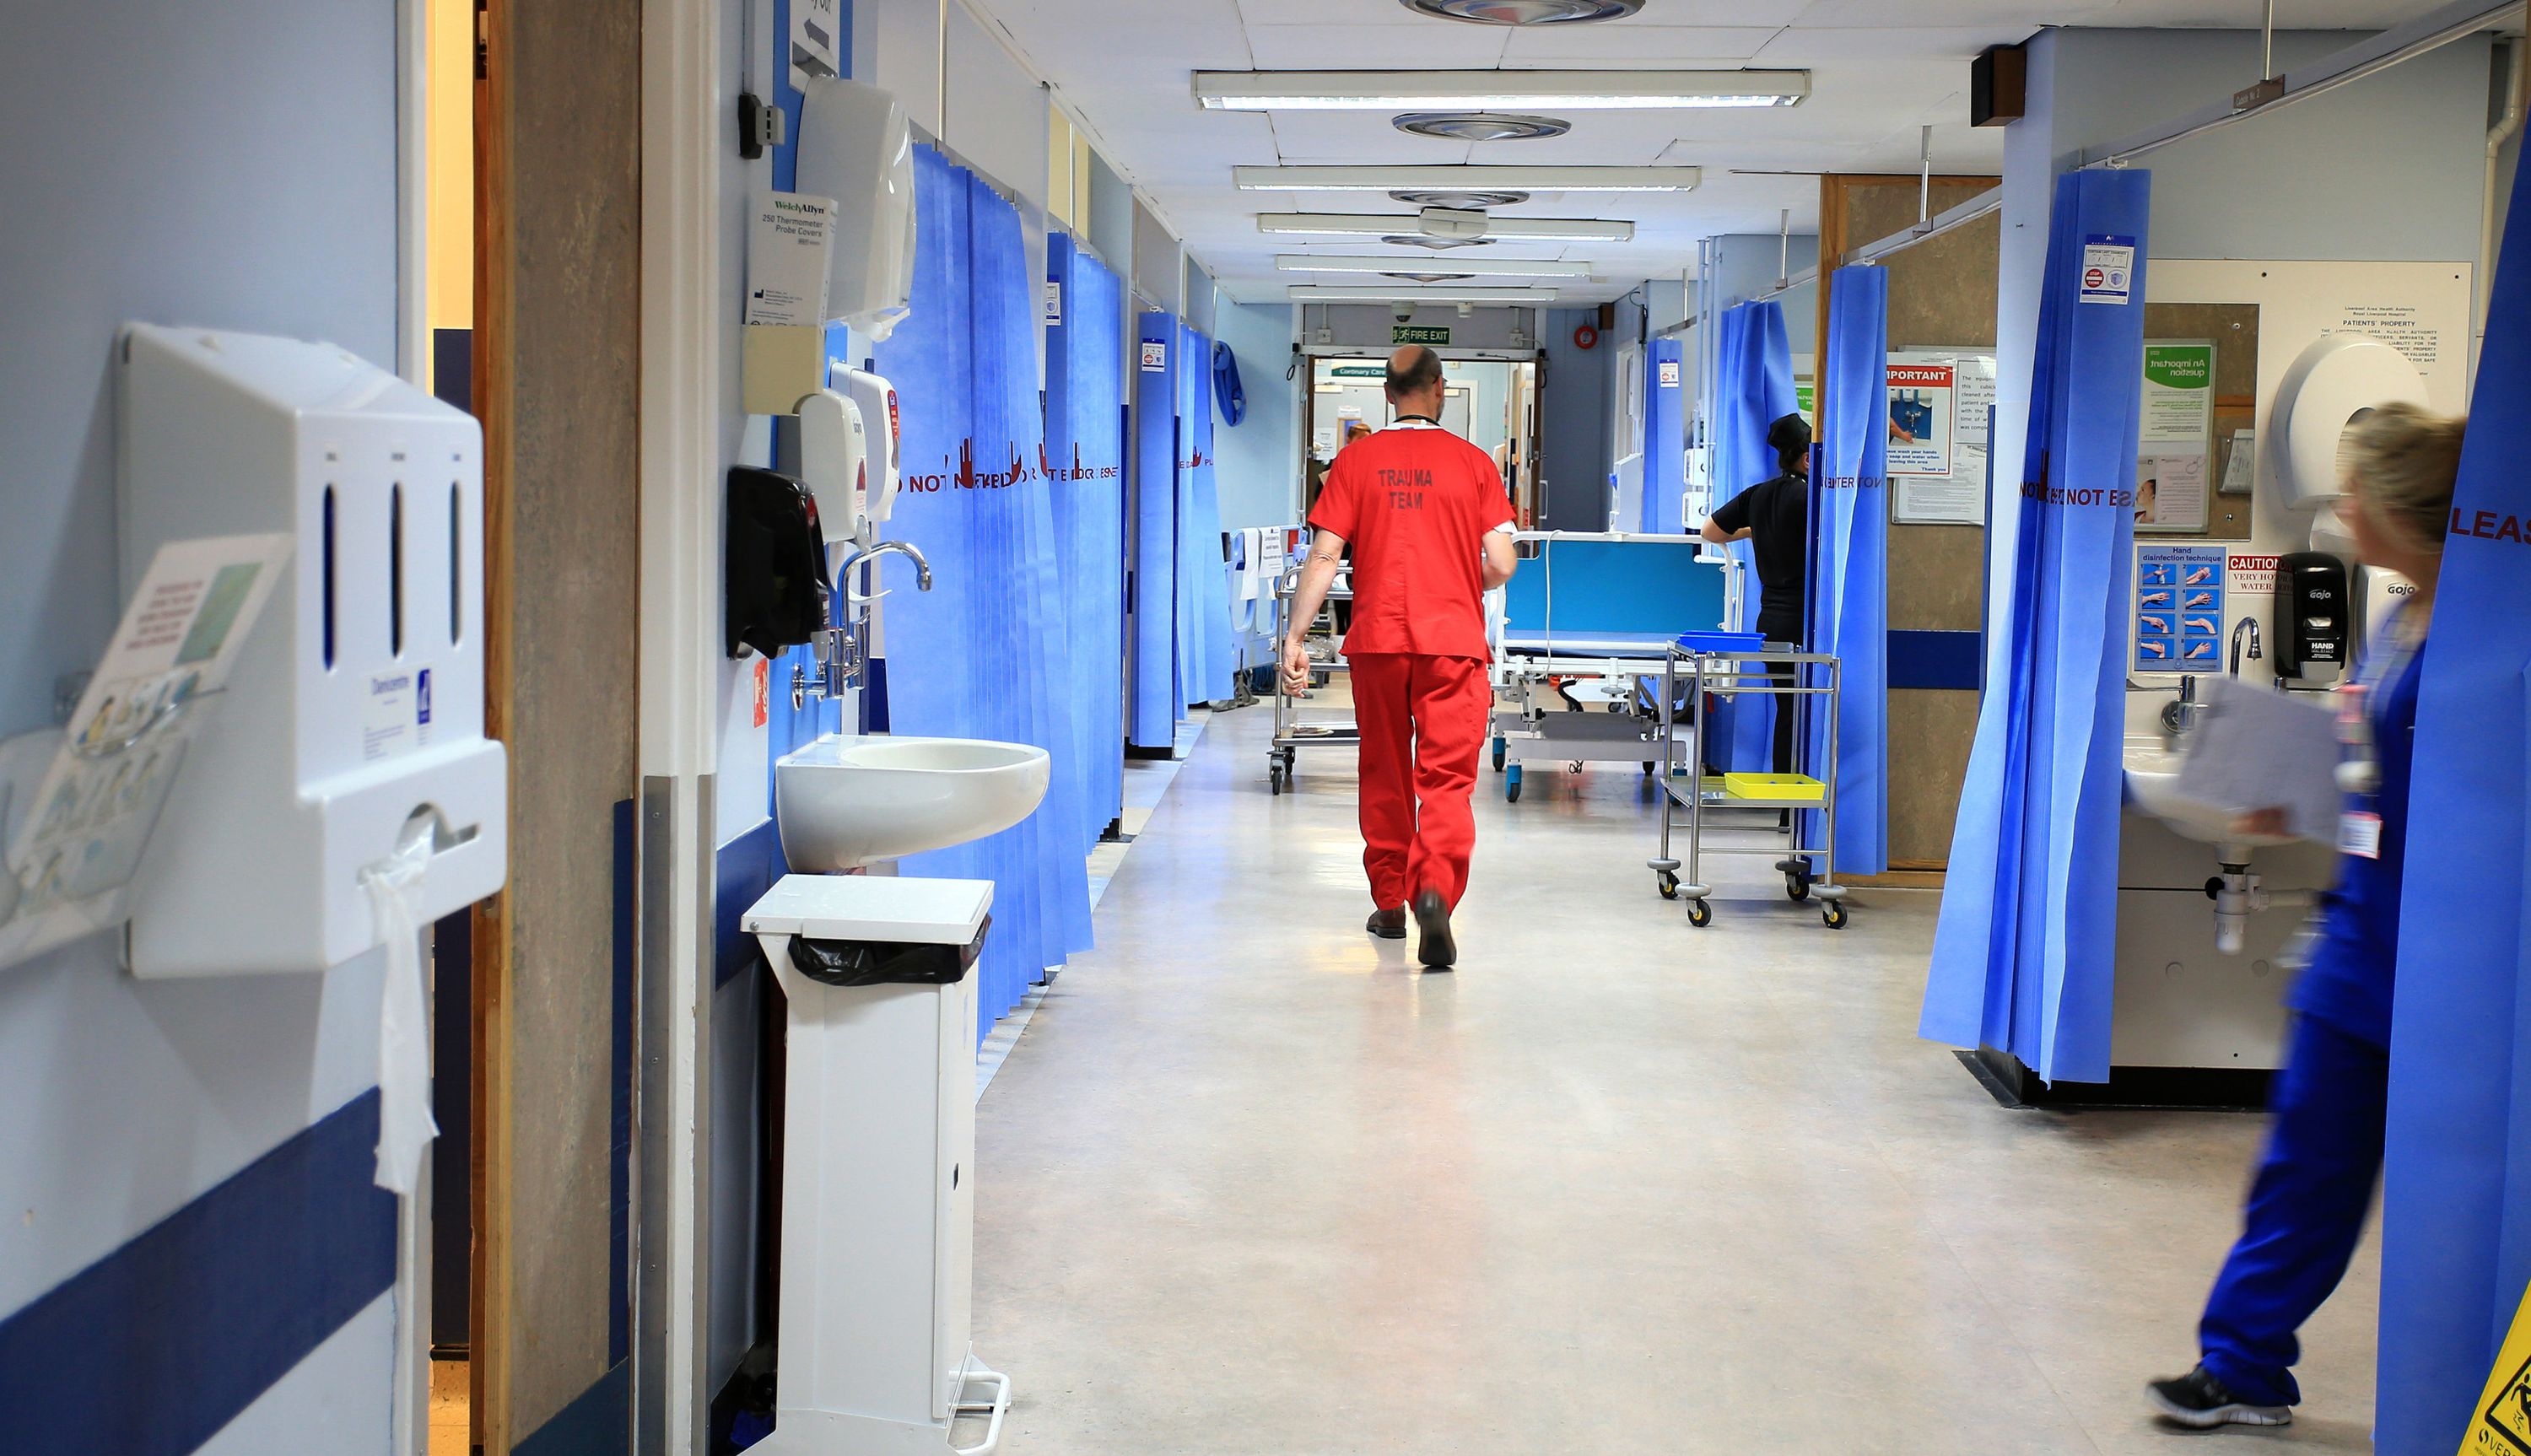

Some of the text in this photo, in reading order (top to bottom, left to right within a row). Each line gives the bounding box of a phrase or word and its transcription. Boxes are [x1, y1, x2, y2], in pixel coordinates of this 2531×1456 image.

[763, 214, 823, 229] 250 Thermometer
[775, 224, 823, 237] Probe Covers
[1411, 331, 1449, 341] FIRE EXIT
[1378, 469, 1433, 487] TRAUMA
[1390, 492, 1422, 510] TEAM
[2067, 488, 2104, 506] NOT
